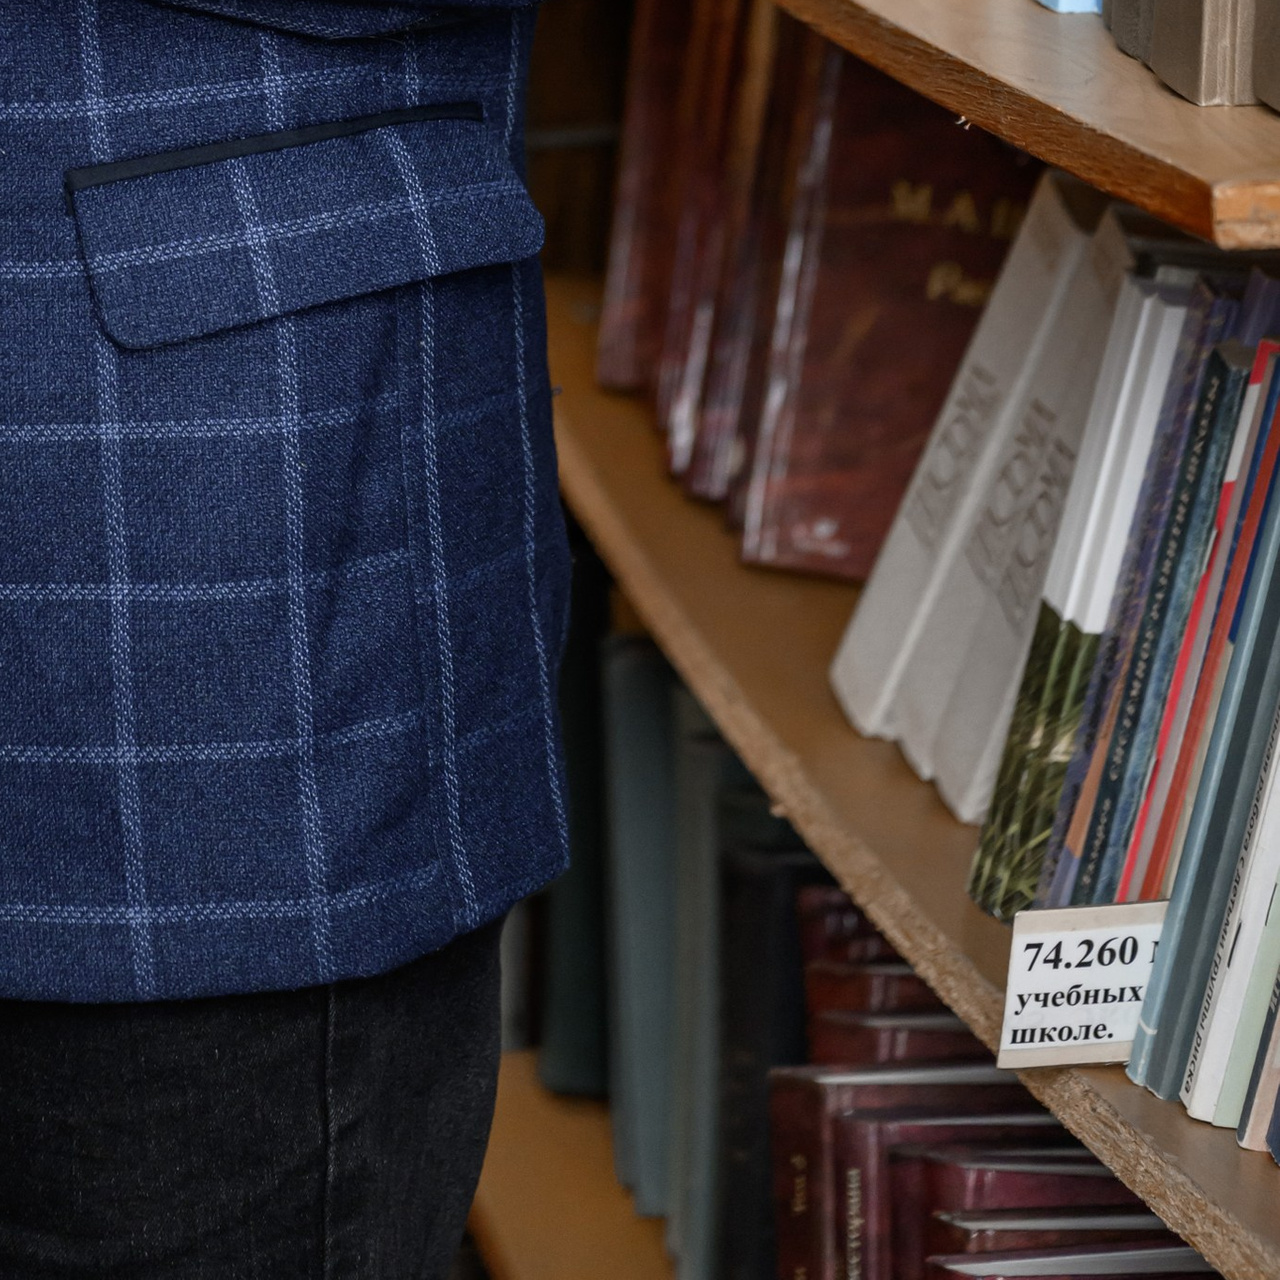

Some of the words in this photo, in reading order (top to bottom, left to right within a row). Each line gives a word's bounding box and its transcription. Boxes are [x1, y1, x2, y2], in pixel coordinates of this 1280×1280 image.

[1243, 775, 1264, 853] работа
[1238, 858, 1246, 870] с
[1216, 871, 1242, 949] детьми
[1023, 935, 1139, 972] 74.260
[1013, 983, 1144, 1016] учебных
[1199, 955, 1223, 1031] группы
[1009, 1022, 1114, 1045] школе.
[1182, 1033, 1203, 1095] риска
